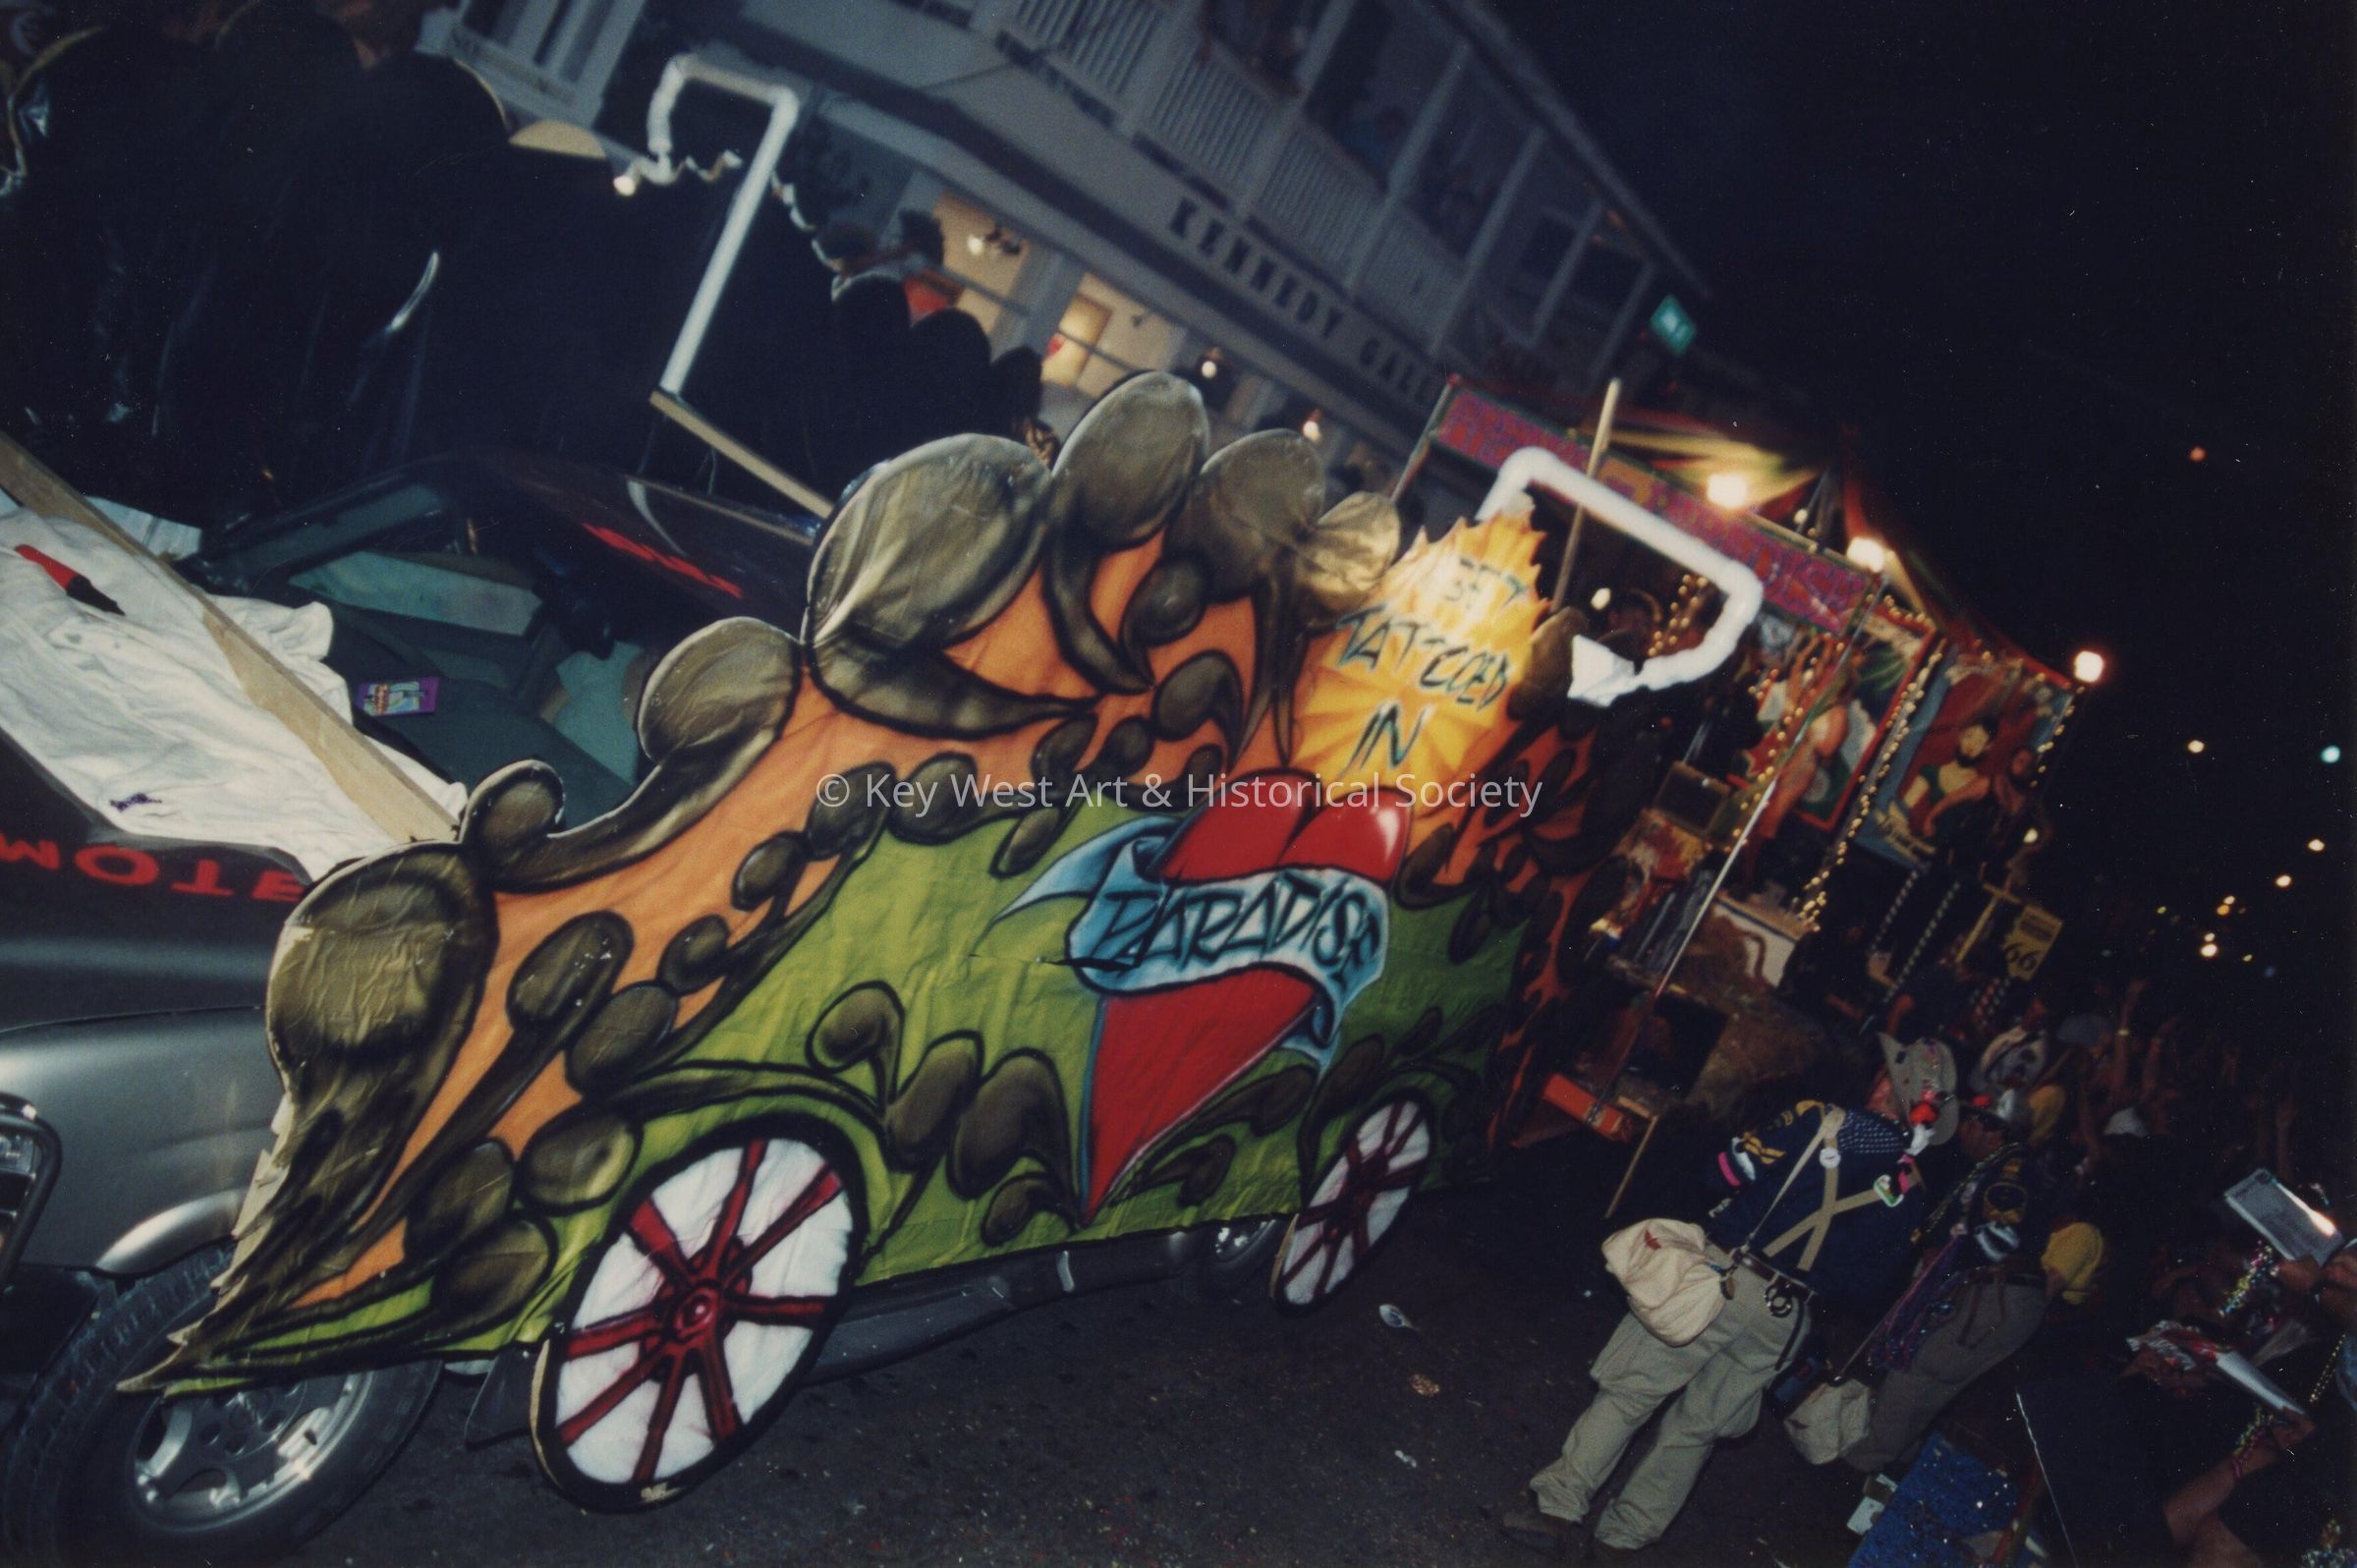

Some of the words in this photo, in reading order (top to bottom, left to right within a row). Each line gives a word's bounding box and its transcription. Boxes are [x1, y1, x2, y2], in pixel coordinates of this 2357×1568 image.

[1170, 197, 1343, 337] KENNEDY
[1338, 701, 1438, 780] IN
[1089, 872, 1381, 982] PARADISE
